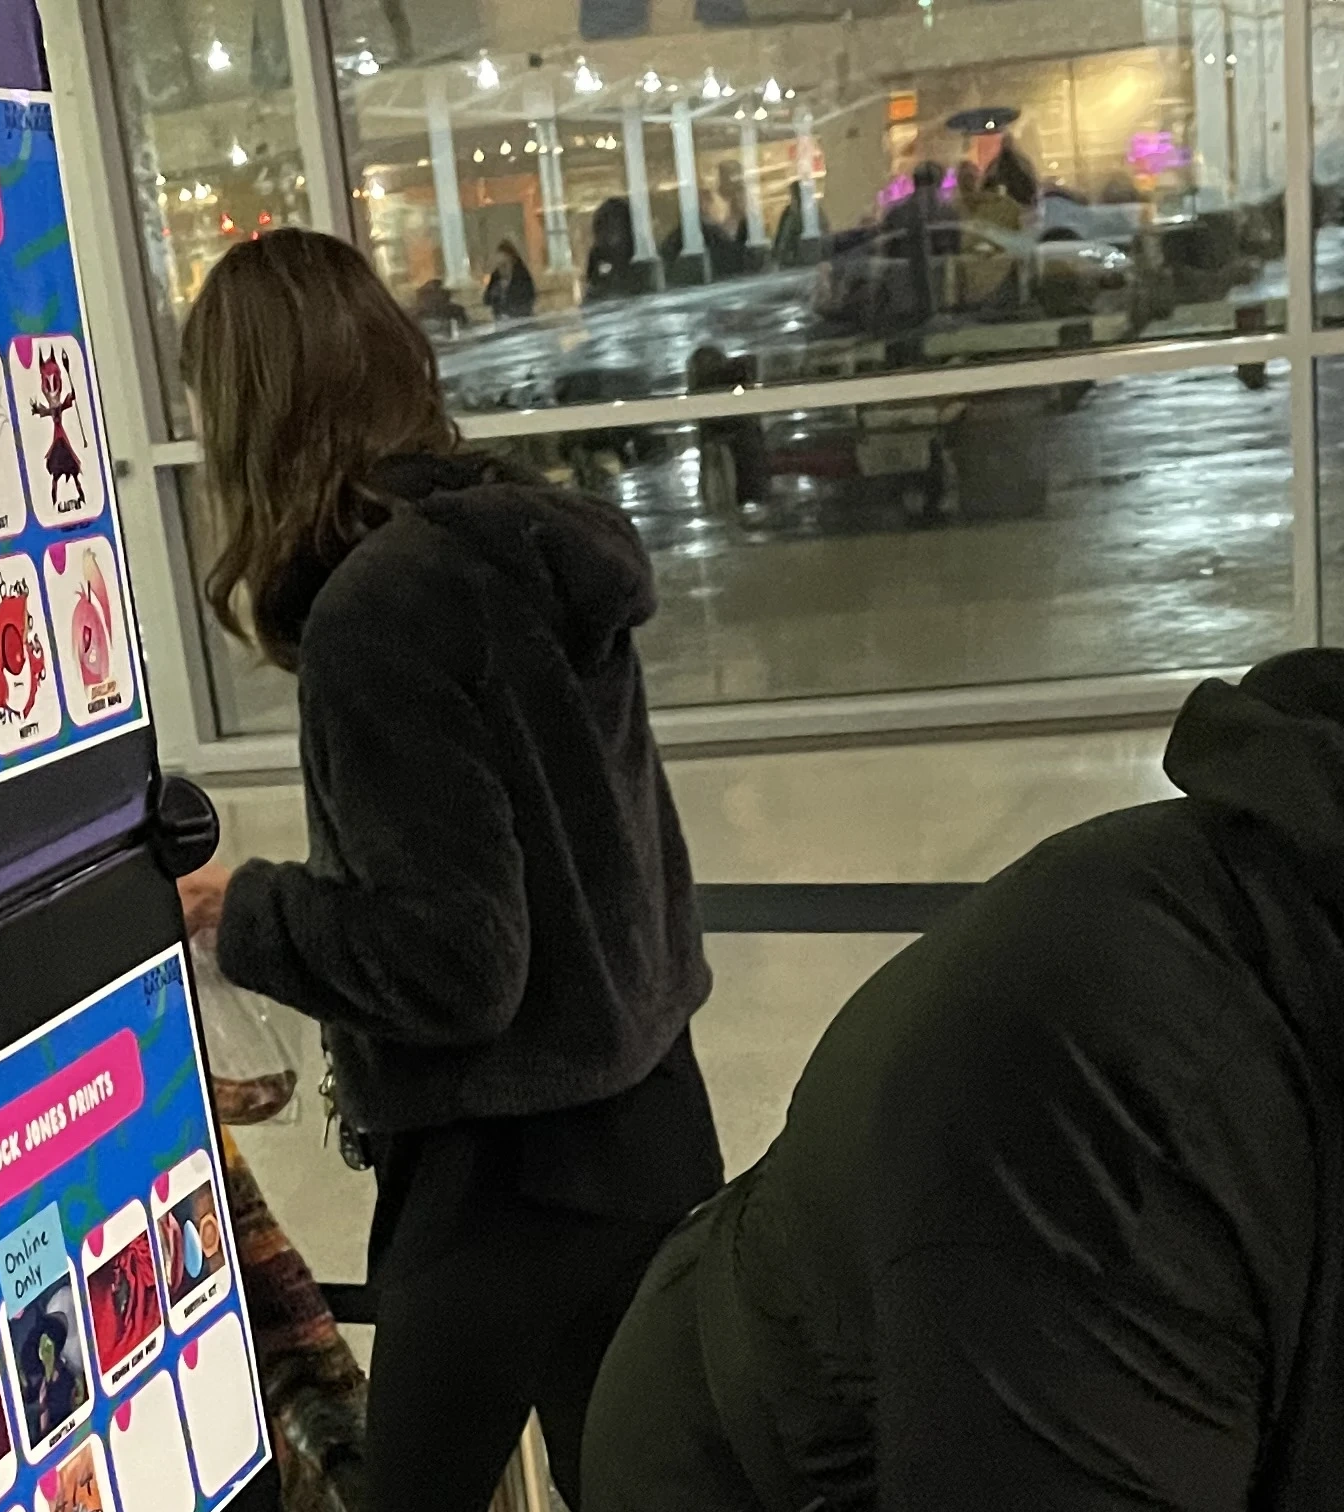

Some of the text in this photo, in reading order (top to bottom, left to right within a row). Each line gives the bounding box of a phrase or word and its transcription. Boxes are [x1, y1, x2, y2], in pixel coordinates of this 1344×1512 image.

[24, 1103, 67, 1152] JONES
[68, 1071, 114, 1122] PRINTS
[4, 1230, 50, 1275] Online
[14, 1261, 44, 1300] Only
